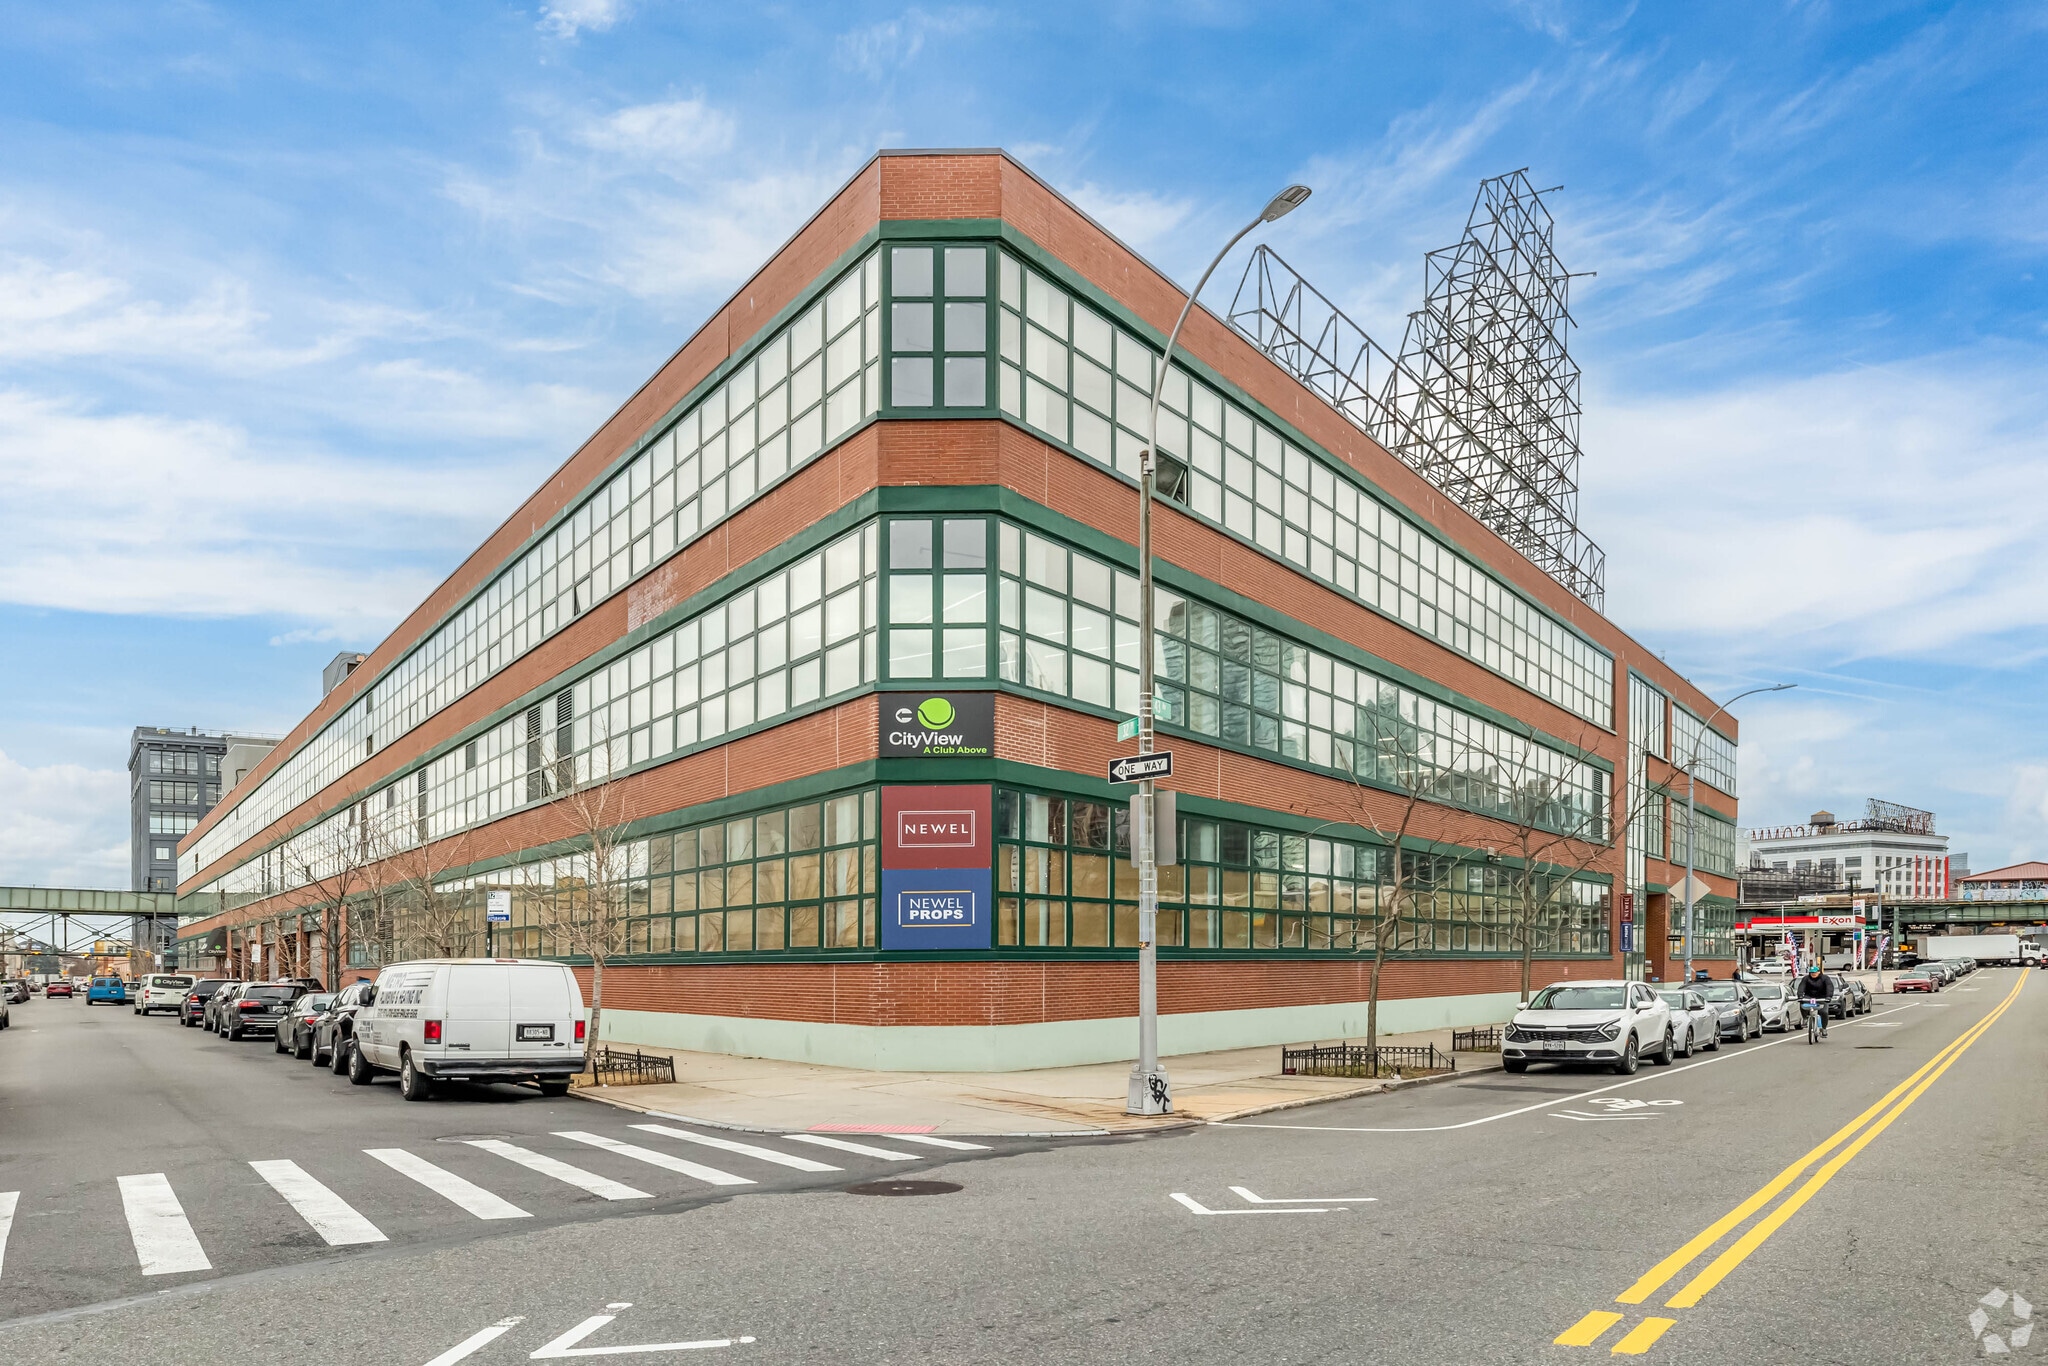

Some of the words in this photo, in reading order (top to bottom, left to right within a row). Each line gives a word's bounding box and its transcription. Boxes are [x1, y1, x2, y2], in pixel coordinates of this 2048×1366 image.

[889, 731, 963, 749] CityView
[923, 746, 931, 754] A
[933, 746, 955, 754] Club
[957, 746, 987, 754] Above
[1118, 765, 1136, 776] ONE
[1144, 760, 1164, 772] WAY
[905, 823, 969, 834] NEWEL
[910, 898, 964, 909] NEWEL
[909, 909, 964, 920] PROPS
[1822, 916, 1852, 926] Exxon
